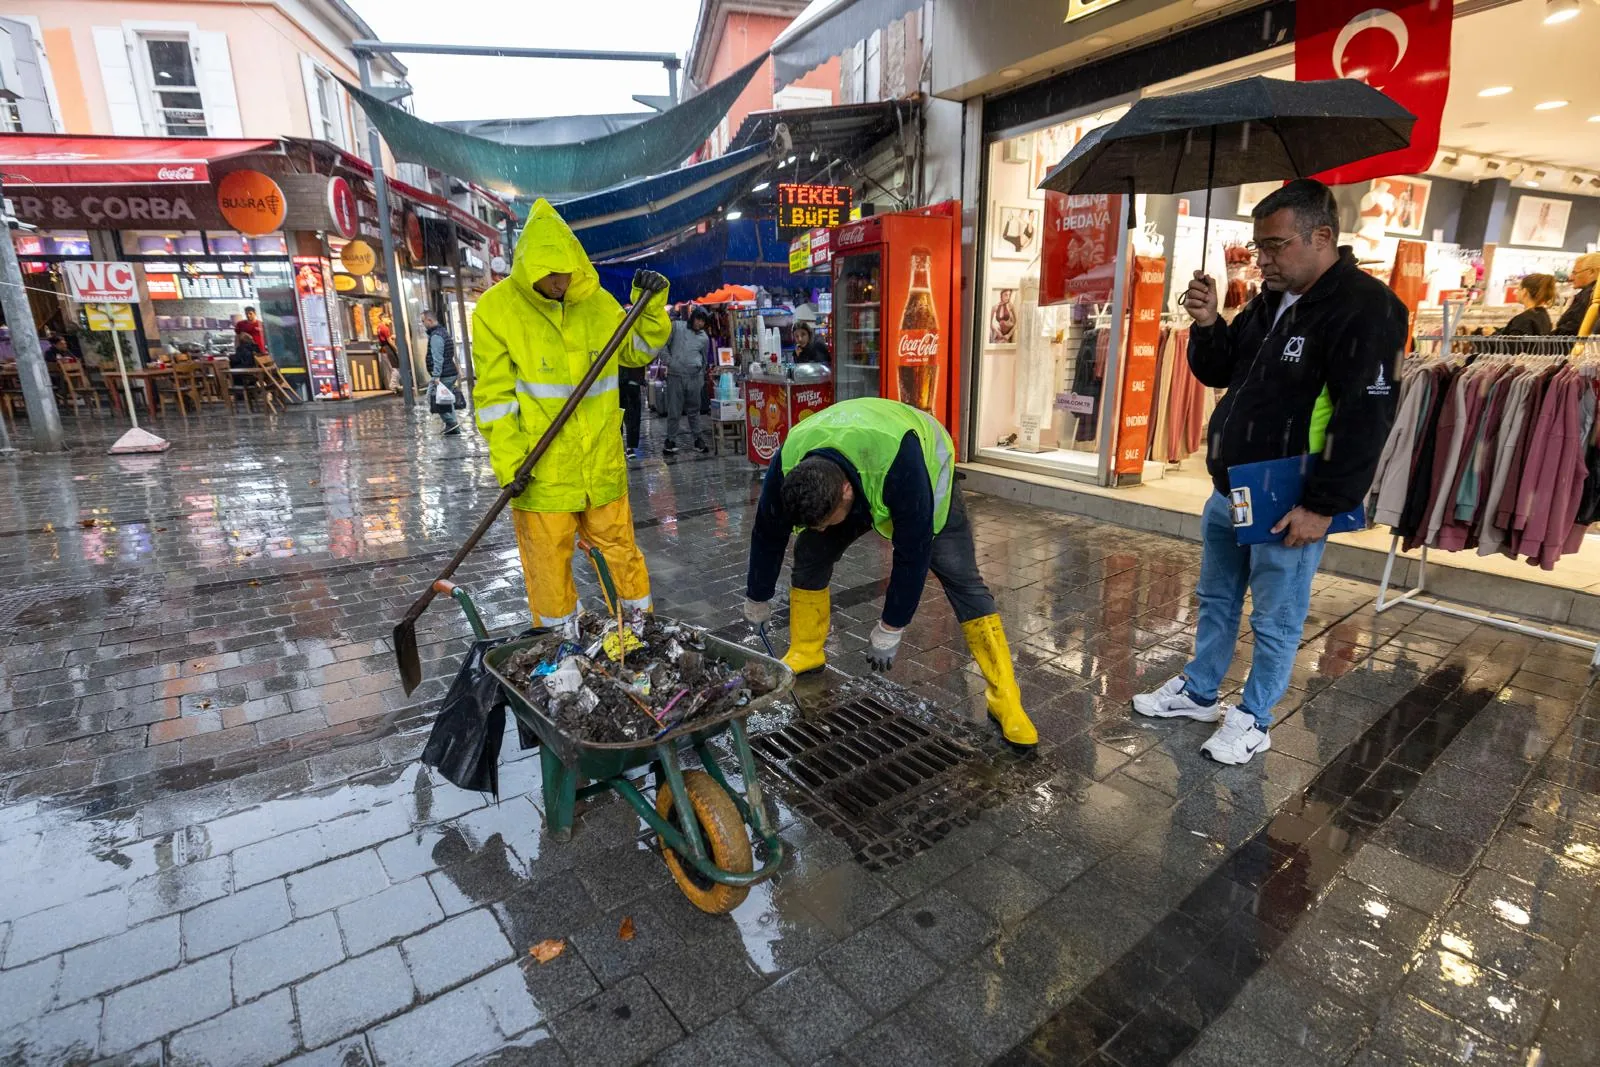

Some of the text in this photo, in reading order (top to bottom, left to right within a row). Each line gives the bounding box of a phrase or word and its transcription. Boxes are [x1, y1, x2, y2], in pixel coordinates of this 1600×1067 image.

[785, 187, 845, 205] TEKEL
[52, 196, 79, 219] &
[81, 196, 196, 224] ÇORBA
[1063, 211, 1112, 231] BEDAVA
[72, 263, 132, 291] WC
[1140, 308, 1155, 320] SALE
[898, 333, 940, 357] Coca-Cola
[1132, 380, 1146, 392] SALE
[1125, 449, 1139, 460] SALE
